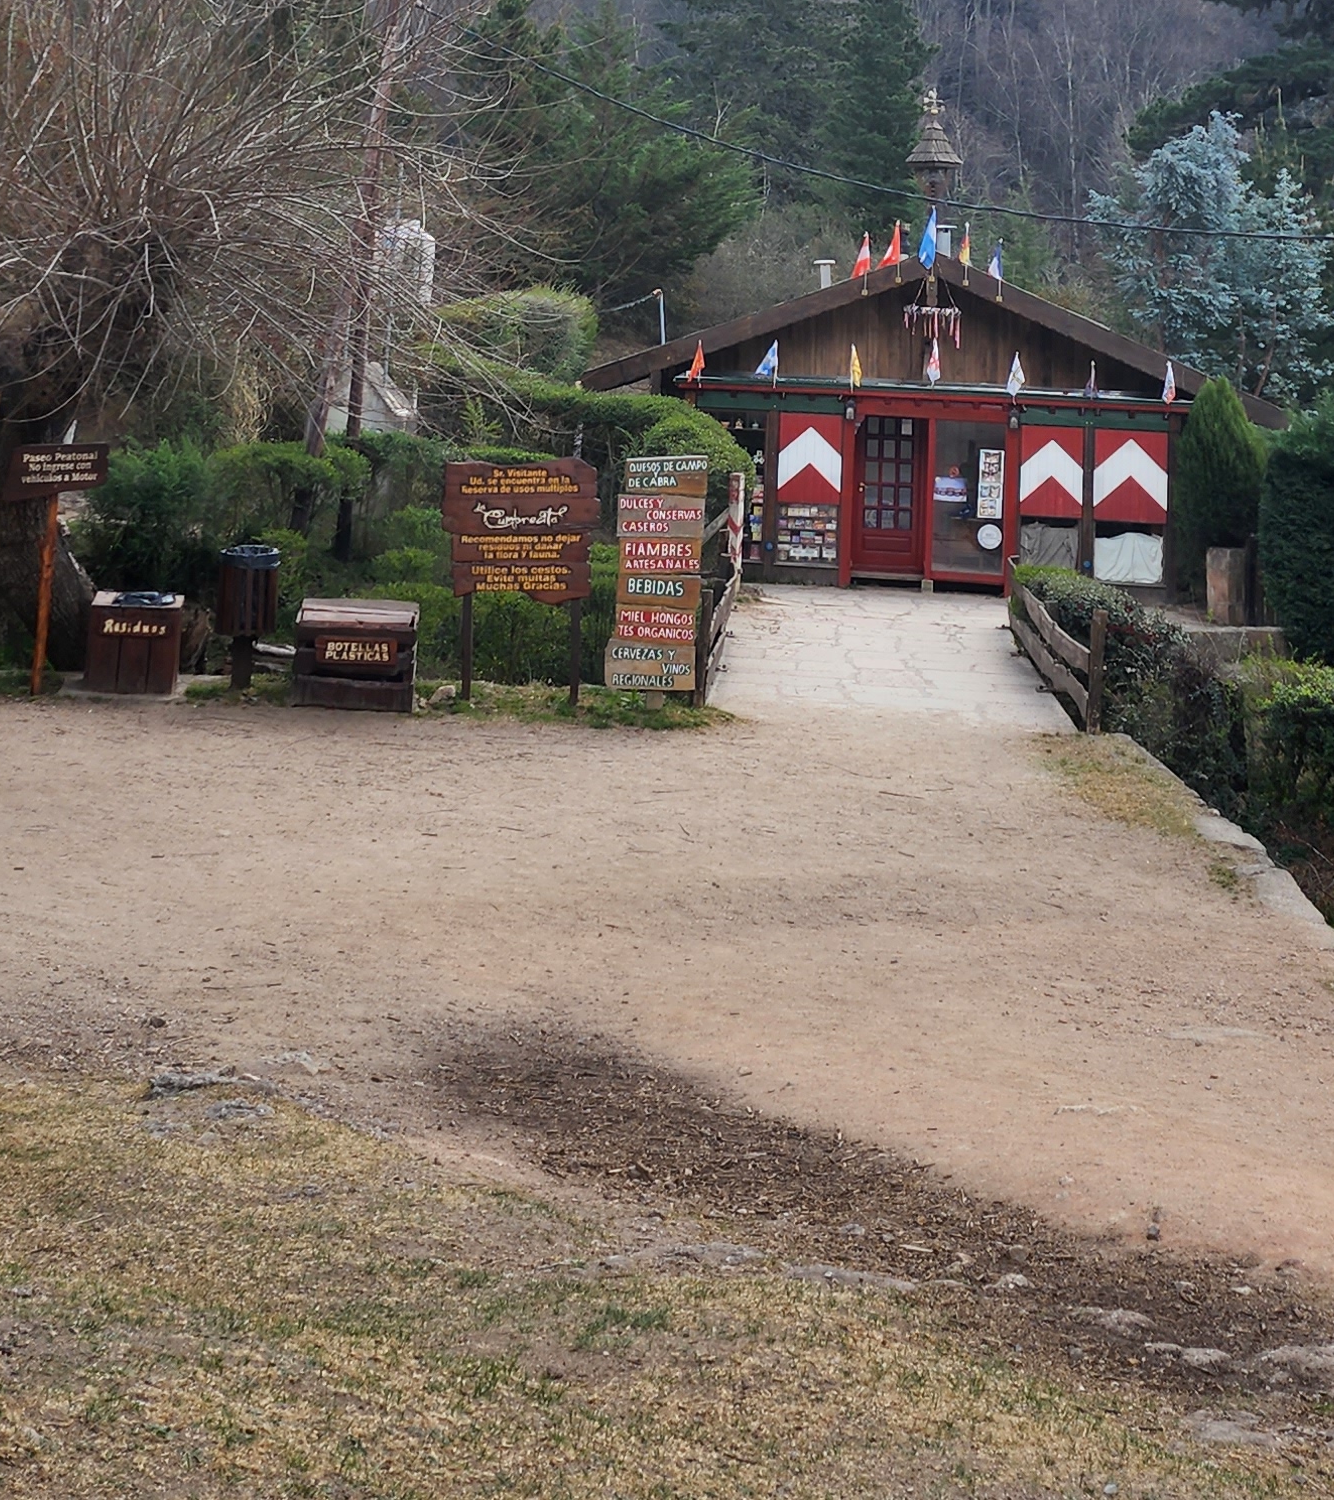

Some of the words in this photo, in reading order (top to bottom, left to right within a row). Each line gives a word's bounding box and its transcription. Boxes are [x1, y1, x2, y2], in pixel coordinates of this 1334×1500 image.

[23, 453, 52, 462] Paseo
[55, 451, 98, 461] Peatonal
[29, 463, 41, 471] No
[76, 461, 91, 469] con
[629, 461, 661, 472] QUESOS
[663, 461, 674, 471] DE
[676, 460, 708, 471] CAMPO
[71, 472, 98, 481] Motor
[507, 469, 547, 477] Visitante
[500, 477, 546, 485] encuentra
[561, 475, 570, 484] la
[628, 477, 641, 488] DE
[642, 476, 677, 487] CABRA
[462, 485, 498, 494] Reserva
[500, 485, 512, 493] de
[620, 498, 654, 509] DULCES
[656, 498, 664, 509] Y
[483, 506, 568, 530] Cumbrecita
[646, 509, 702, 521] CONSERVAS
[622, 521, 669, 532] CASEROS
[461, 534, 539, 544] Recomendamos
[555, 534, 581, 544] dejar
[625, 542, 692, 556] FIAMBRES
[484, 551, 494, 559] la
[496, 551, 519, 559] flora
[625, 559, 700, 569] ARTESANALES
[472, 566, 508, 575] Utilice
[511, 565, 528, 574] los
[487, 574, 515, 582] Evite
[517, 574, 556, 582] multas
[476, 582, 520, 591] Muchas
[523, 582, 567, 590] Gracias
[628, 578, 684, 596] BEBIDAS
[620, 610, 646, 622] MIEL
[651, 612, 693, 625] HONGOS
[103, 619, 166, 635] Residuos
[618, 624, 634, 636] TES
[637, 627, 694, 640] ORGANICOS
[327, 641, 388, 652] BOTELLAS
[325, 650, 389, 661] PLASTICAS
[611, 647, 663, 660] CERVEZAS
[668, 650, 676, 660] Y
[661, 662, 691, 675] VINOS
[612, 673, 673, 687] REGIONALES
